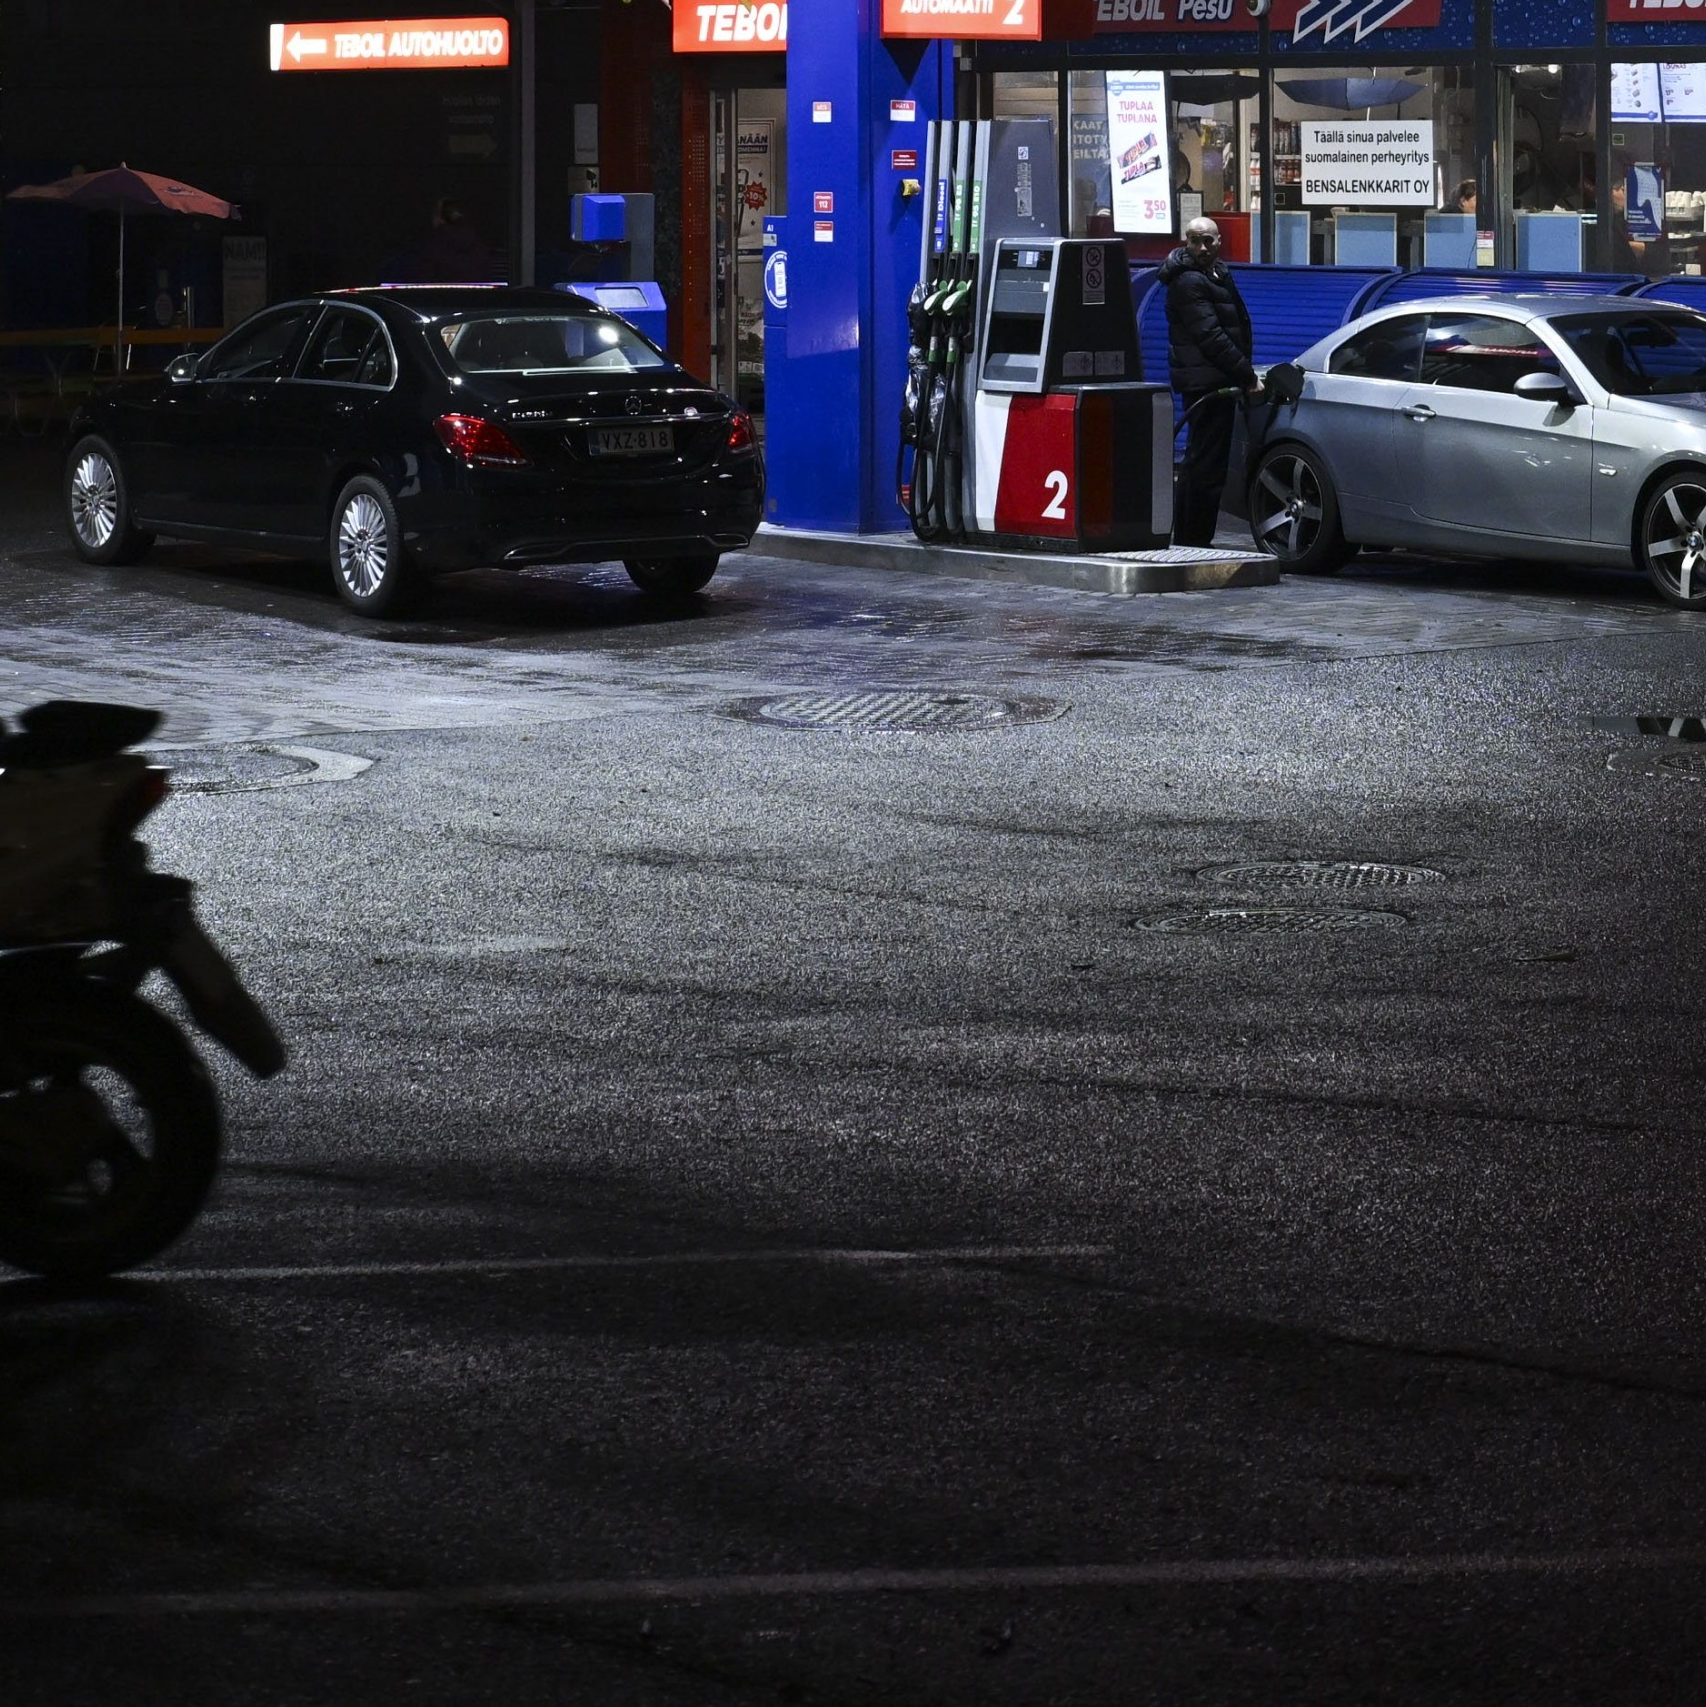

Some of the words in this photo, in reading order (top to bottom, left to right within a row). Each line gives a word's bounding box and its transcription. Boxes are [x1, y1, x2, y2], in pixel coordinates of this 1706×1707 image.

[334, 33, 386, 58] TEBOIL
[387, 29, 503, 57] AUTOHUOLTO
[1119, 101, 1153, 110] TUPLAA
[1117, 114, 1157, 123] TUPLANA
[1313, 130, 1344, 143] Täällä
[1346, 131, 1374, 143] sinua
[1377, 130, 1420, 145] palvelee
[1305, 150, 1369, 163] suomalainen
[1371, 150, 1430, 165] perheyritys
[1306, 179, 1411, 193] BENSALENKKARIT
[1413, 179, 1430, 193] OY
[601, 430, 669, 450] VXZ-818
[1041, 470, 1068, 520] 2
